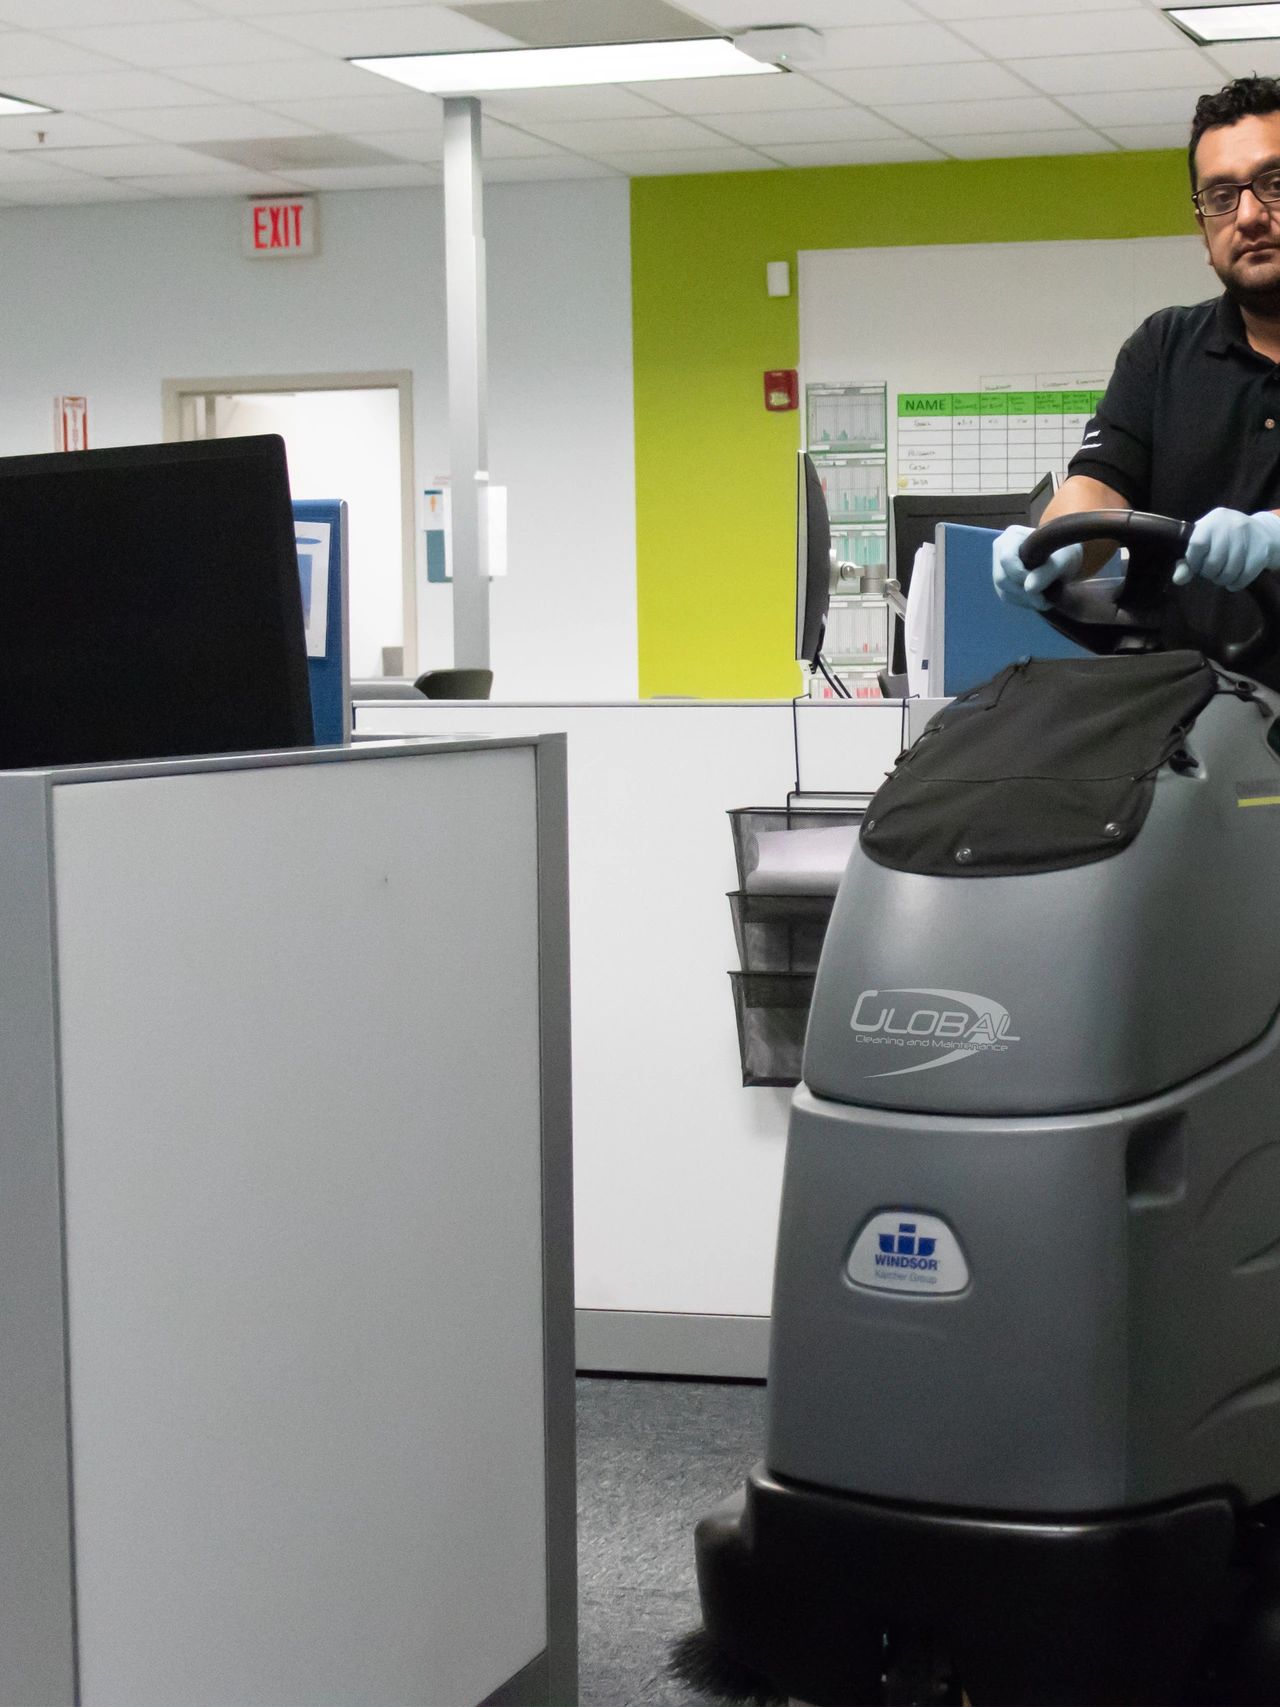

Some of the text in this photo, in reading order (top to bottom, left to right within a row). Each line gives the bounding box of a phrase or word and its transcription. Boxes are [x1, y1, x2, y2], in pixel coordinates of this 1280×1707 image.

[253, 204, 303, 249] EXIT
[905, 399, 946, 412] NAME
[850, 990, 1021, 1041] GLOBAL
[855, 1034, 1009, 1052] Cleaning and Maintenance
[875, 1254, 938, 1271] WINDSOR
